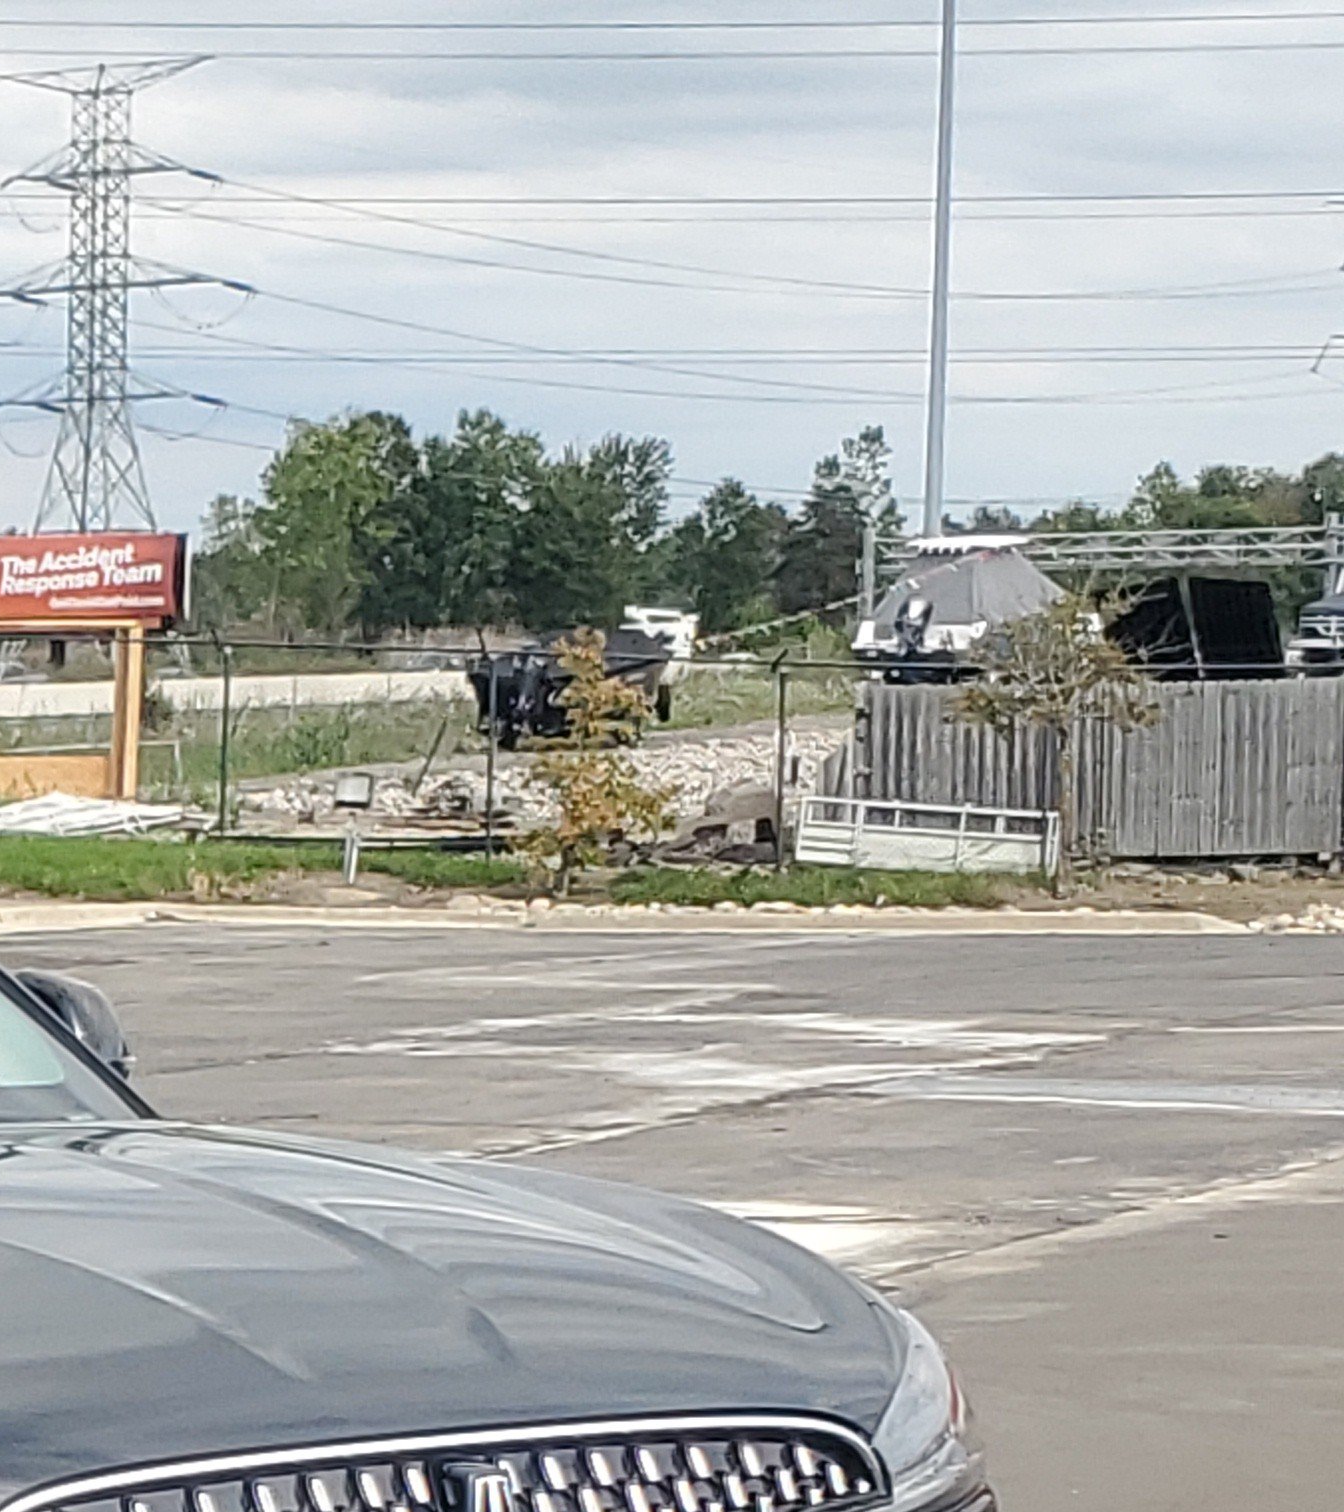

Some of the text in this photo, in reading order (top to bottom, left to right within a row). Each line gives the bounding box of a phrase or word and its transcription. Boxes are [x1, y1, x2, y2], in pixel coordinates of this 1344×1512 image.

[1, 543, 135, 575] The Accident
[0, 564, 162, 597] Response Team
